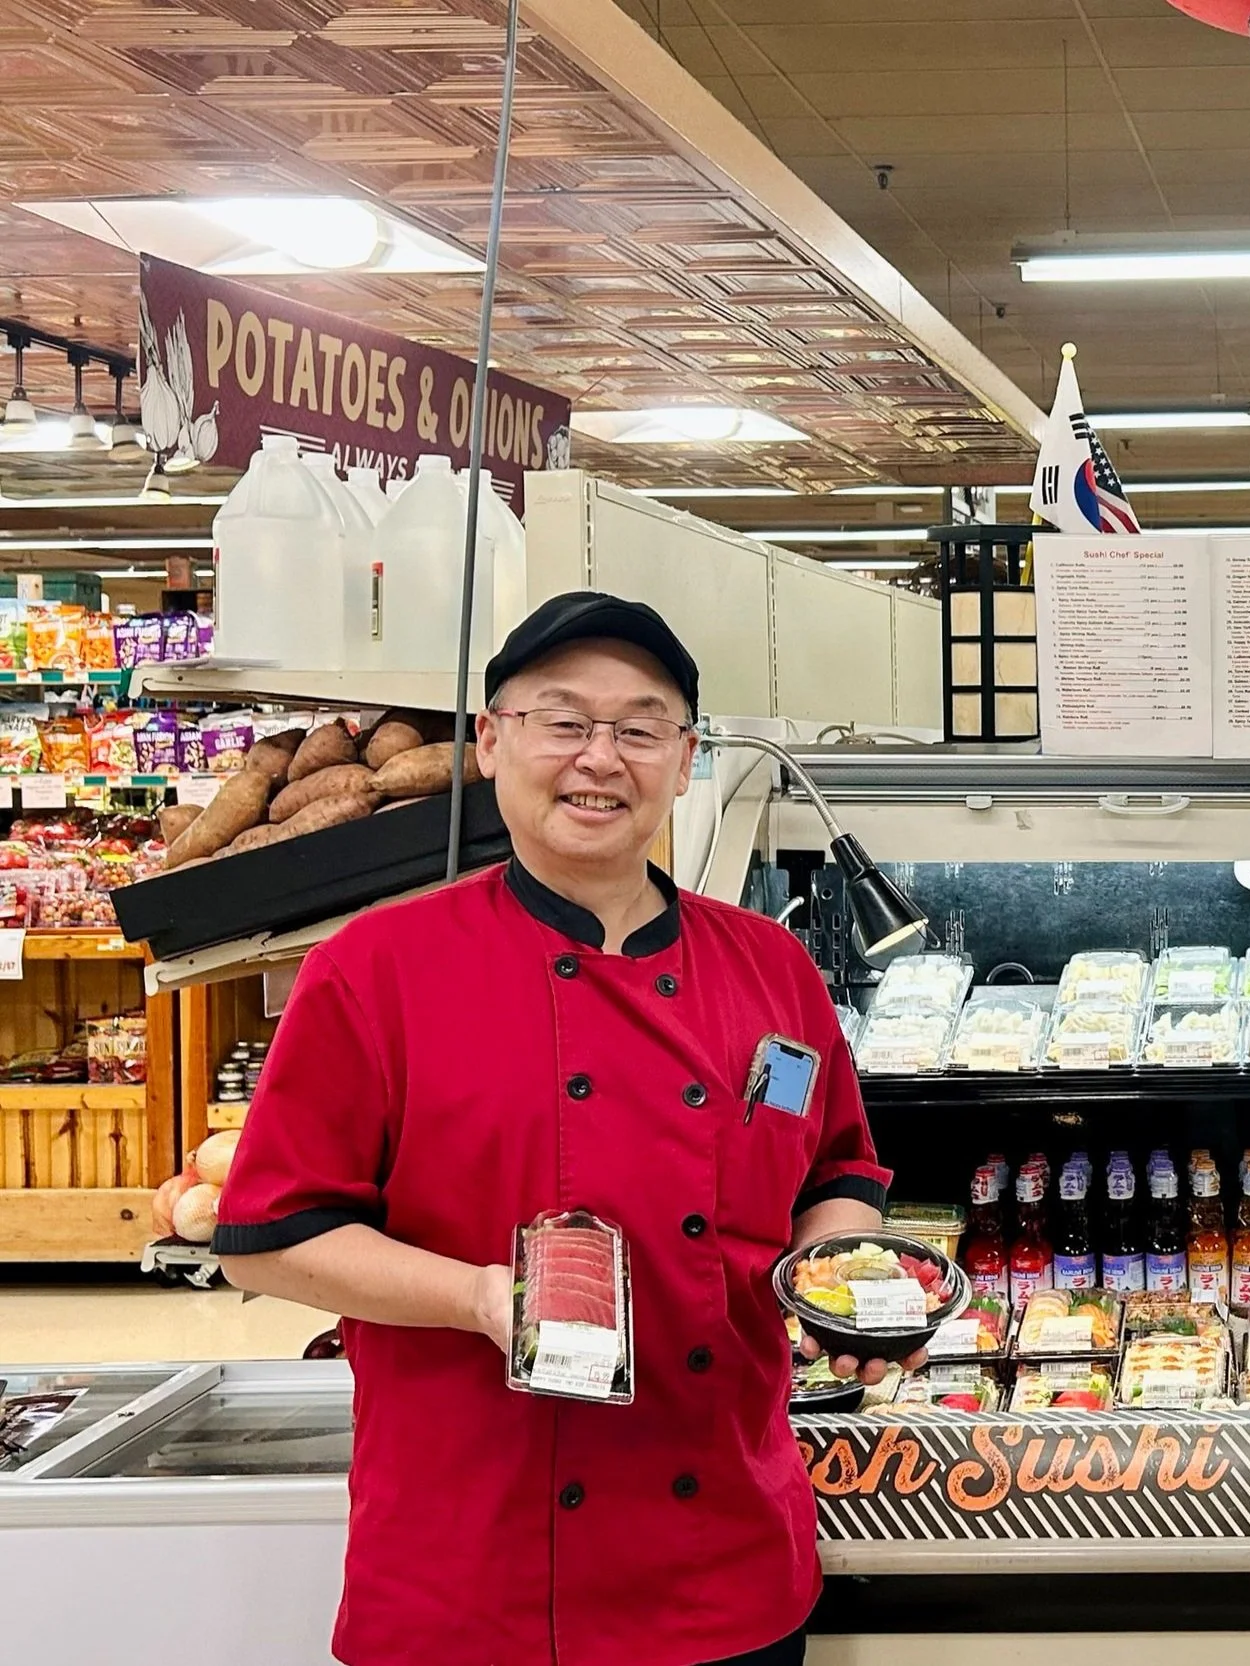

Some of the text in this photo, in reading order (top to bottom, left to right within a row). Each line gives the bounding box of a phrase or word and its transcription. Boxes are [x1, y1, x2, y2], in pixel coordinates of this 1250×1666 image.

[206, 299, 406, 432] POTATOES
[416, 365, 438, 444] &
[332, 442, 408, 480] ALWAYS
[1083, 551, 1107, 559] Sushi
[1133, 551, 1164, 559] Special
[215, 736, 246, 750] GARLIC
[946, 1424, 1231, 1511] Sushi
